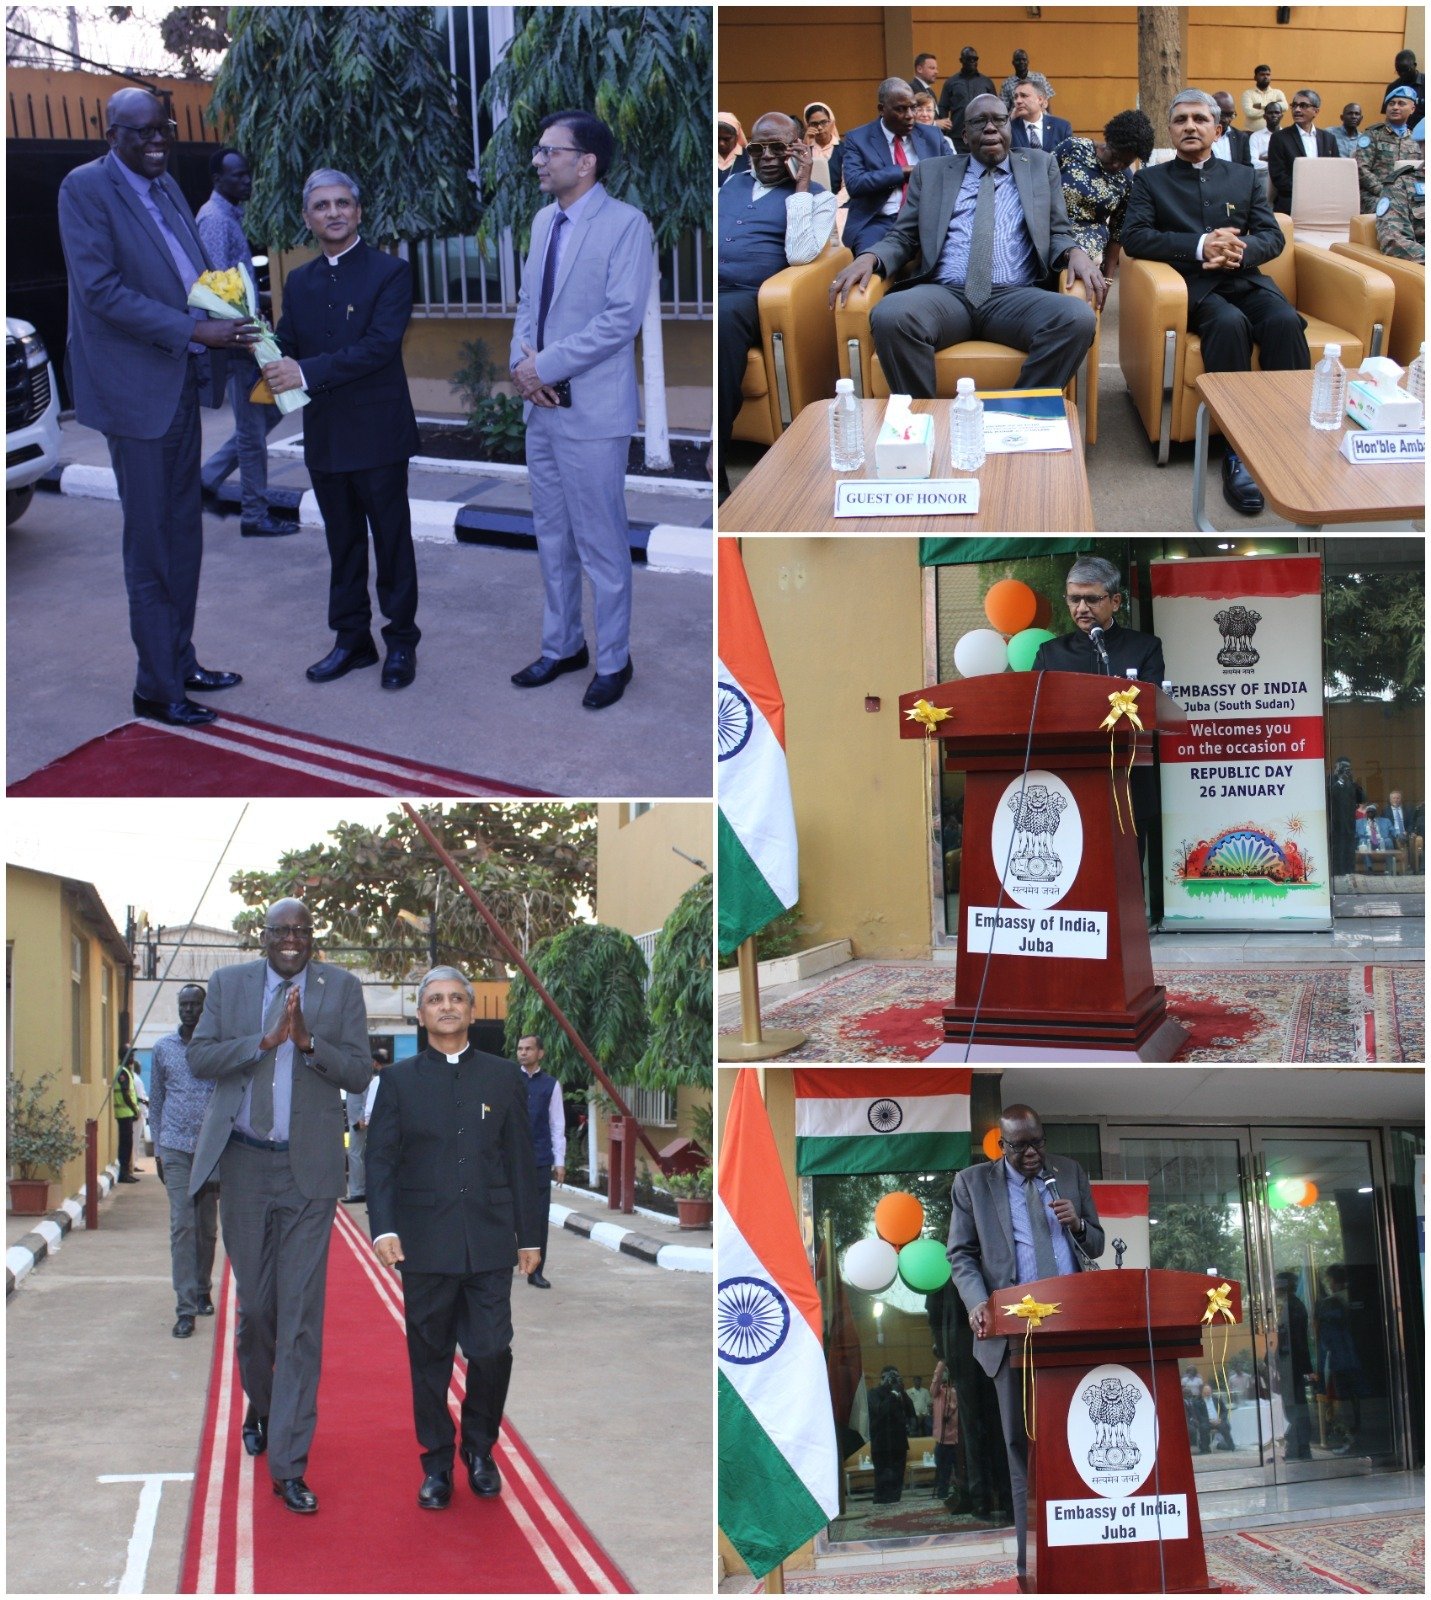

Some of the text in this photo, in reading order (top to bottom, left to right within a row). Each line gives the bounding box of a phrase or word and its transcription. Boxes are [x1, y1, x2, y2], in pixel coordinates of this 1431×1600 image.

[1355, 439, 1425, 454] Hon'ble Amb
[846, 492, 968, 505] GUEST OF HONOR
[1171, 681, 1307, 698] EMBASSY OF INDIA
[1184, 698, 1295, 713] Juba (South Sudan)
[1190, 722, 1291, 738] Welcomes you
[1178, 738, 1306, 755] on the occasion of
[1190, 765, 1294, 780] REPUBLIC DAY
[1200, 784, 1286, 798] 26 JANUARY
[975, 913, 1101, 935] Embassy of India,
[1018, 937, 1054, 953] Juba
[1054, 1500, 1181, 1521] Embassy of India,
[1101, 1525, 1137, 1540] Juba
